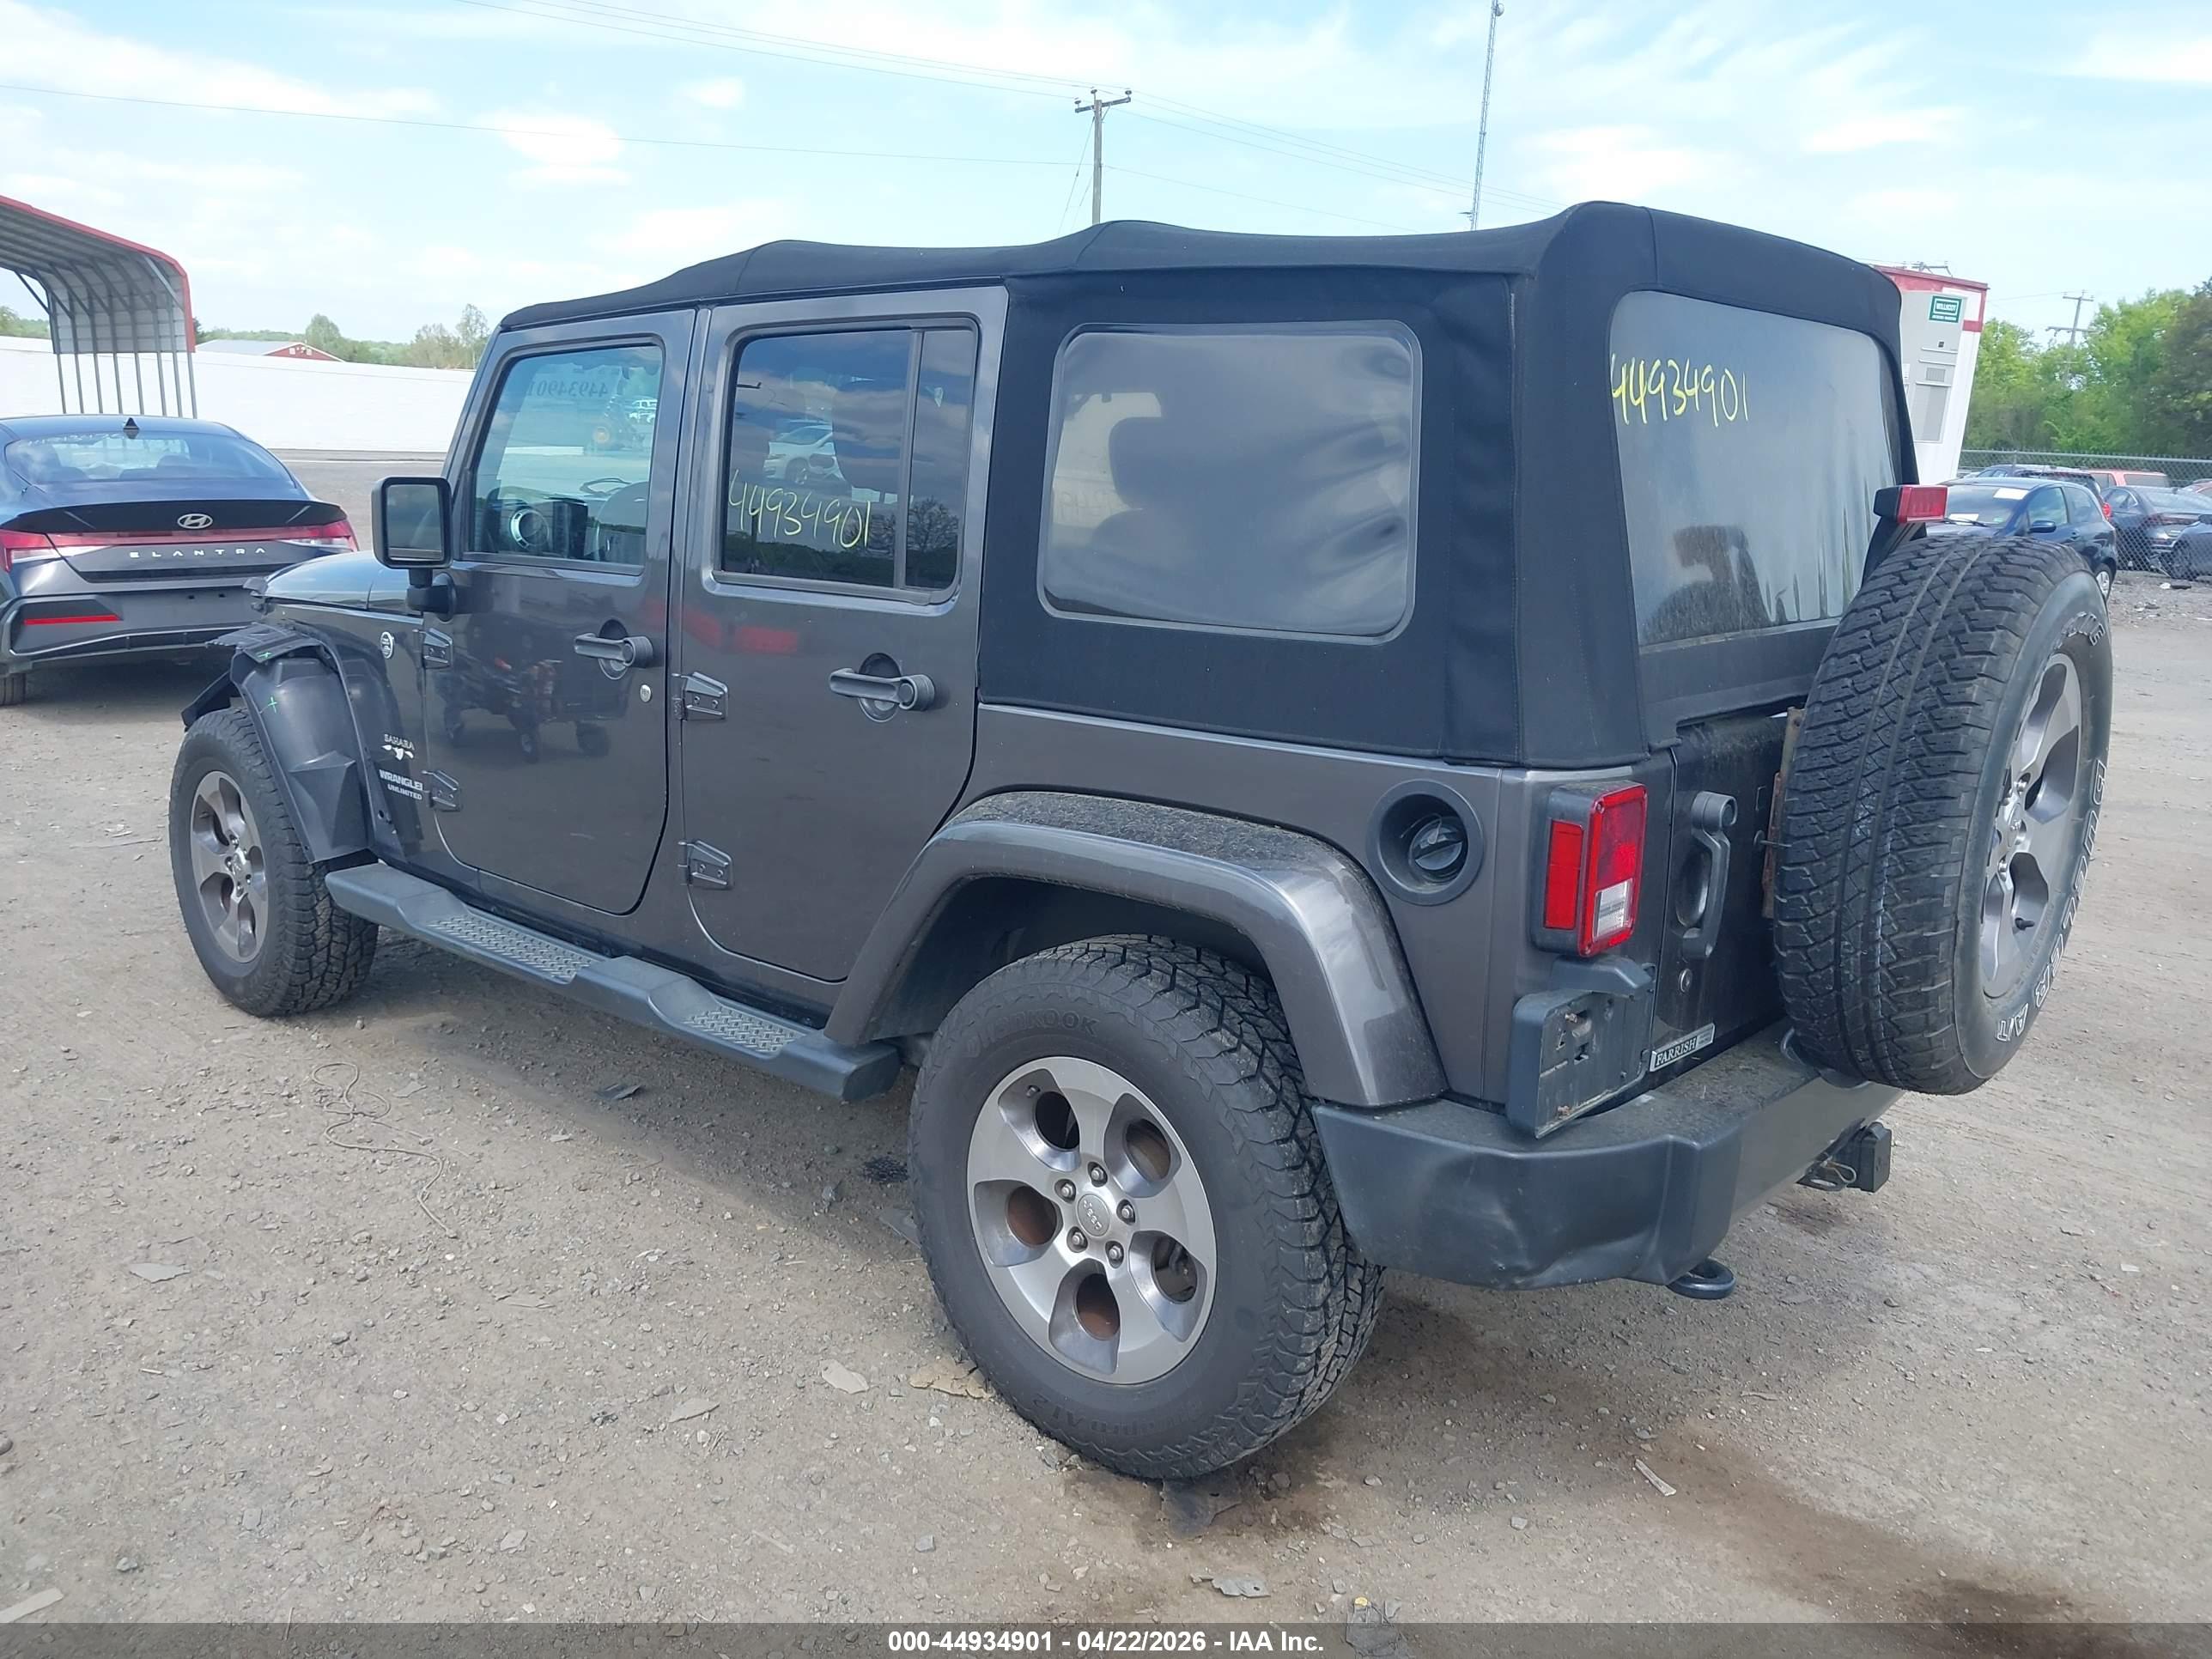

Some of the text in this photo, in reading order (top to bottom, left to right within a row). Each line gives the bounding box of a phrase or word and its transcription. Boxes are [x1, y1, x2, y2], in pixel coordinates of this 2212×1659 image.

[1610, 353, 1749, 428] 44934901
[728, 469, 871, 549] 44934901
[130, 548, 266, 558] ELANTRA
[384, 733, 416, 750] SAHARA
[387, 783, 422, 800] UNLIMITED
[2032, 758, 2106, 1008] DUELER
[1656, 1036, 1698, 1066] FARRISH
[1083, 1200, 1103, 1231] Jeep
